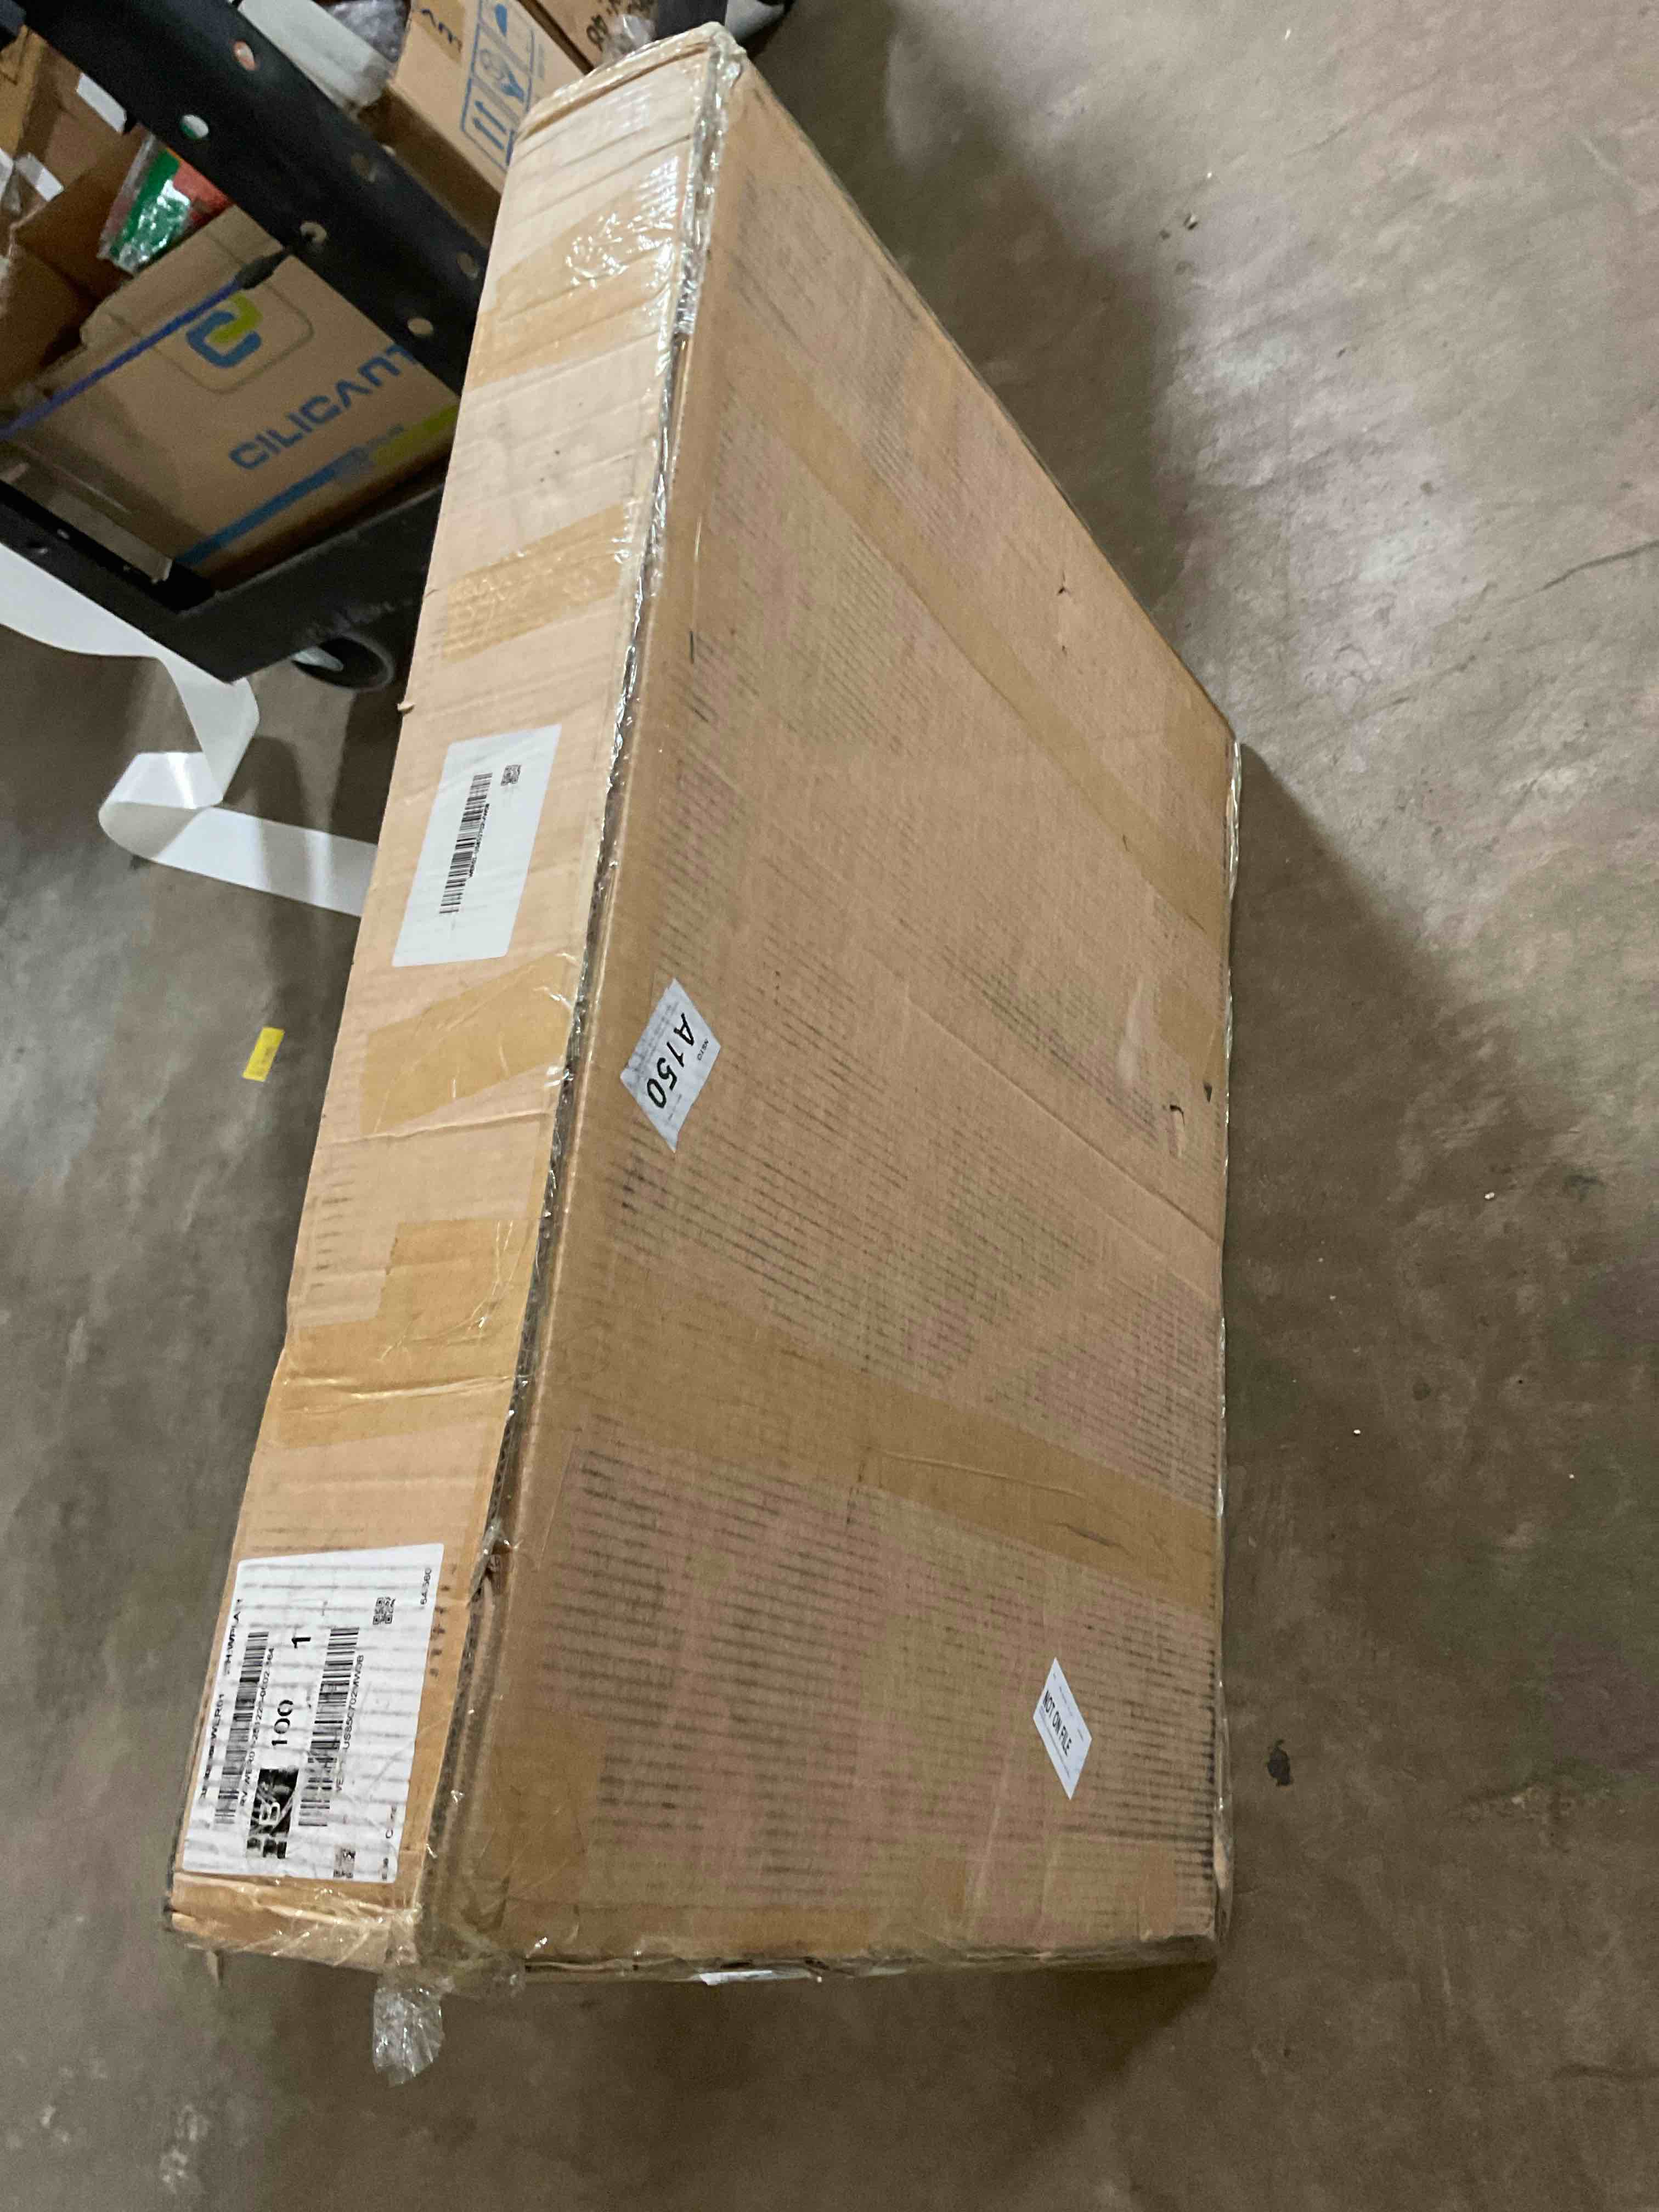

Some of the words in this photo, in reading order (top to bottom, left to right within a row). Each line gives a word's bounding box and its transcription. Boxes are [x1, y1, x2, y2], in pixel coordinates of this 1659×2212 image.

[646, 1012, 695, 1109] A150
[271, 1699, 294, 1747] 100
[291, 1636, 312, 1650] 1
